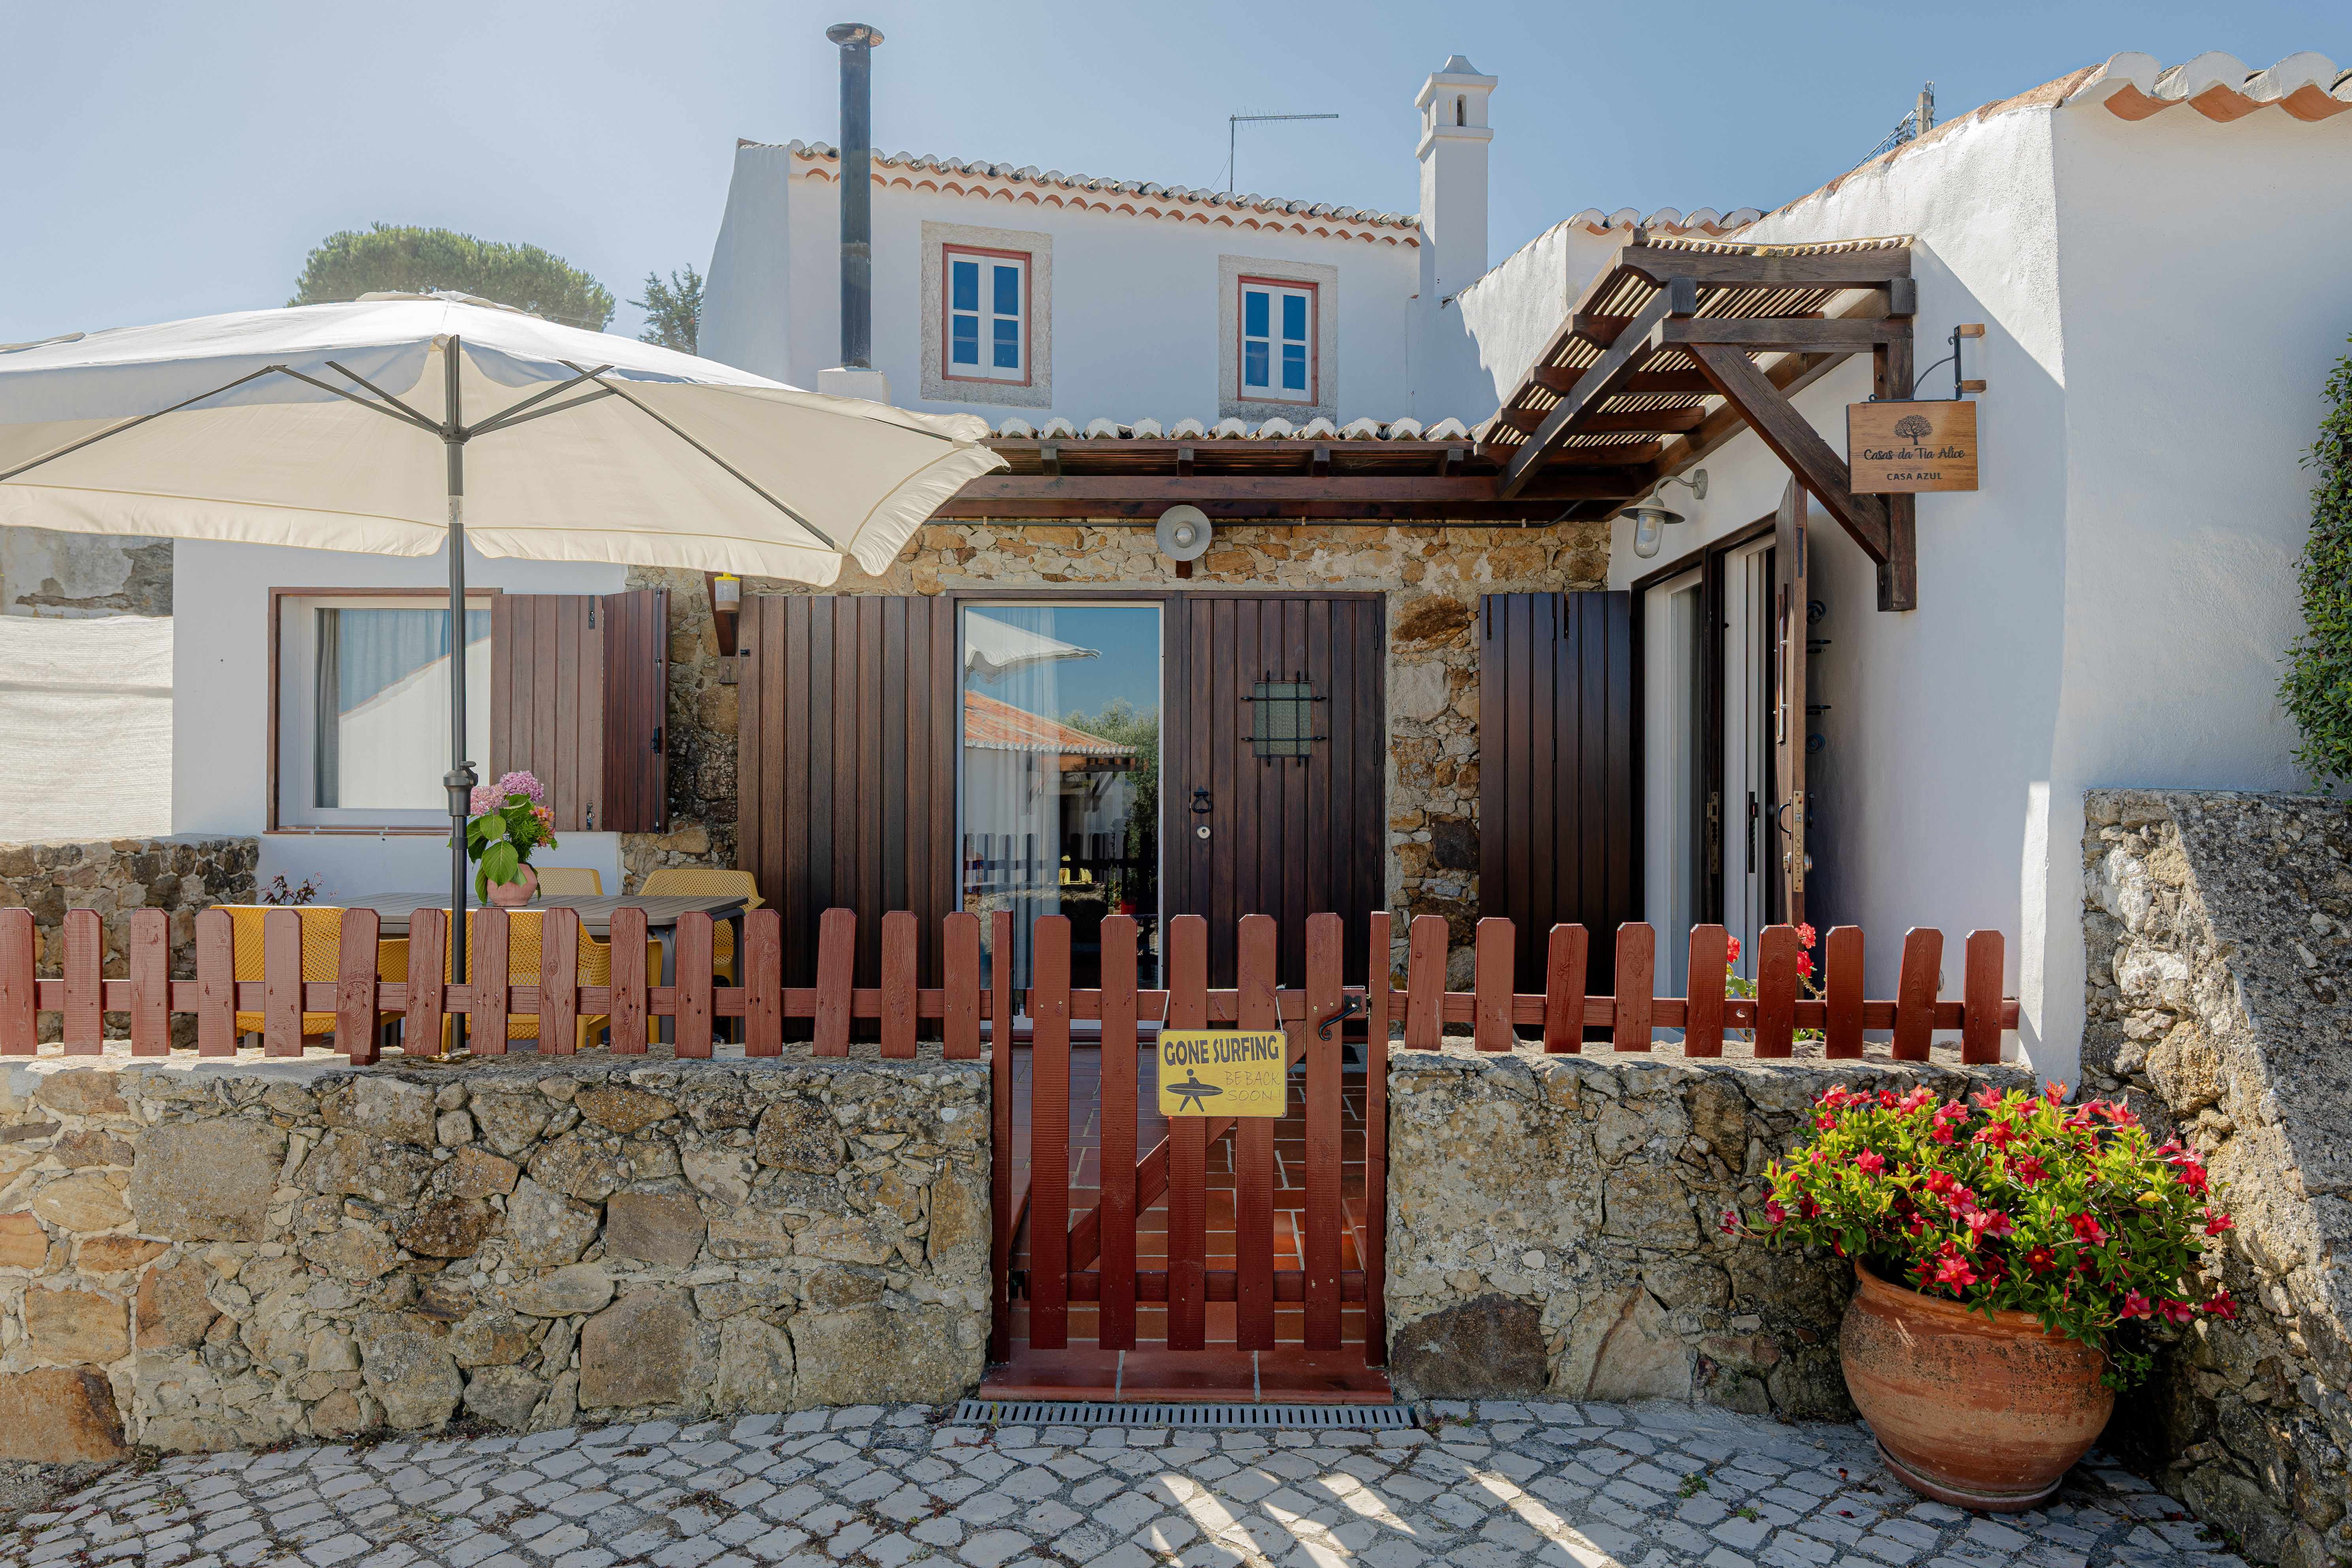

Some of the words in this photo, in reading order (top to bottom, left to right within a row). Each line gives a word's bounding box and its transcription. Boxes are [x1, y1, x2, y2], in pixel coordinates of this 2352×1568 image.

[1864, 449, 1894, 460] Casas
[1898, 448, 1913, 459] da
[1915, 448, 1935, 459] Tia
[1937, 446, 1965, 458] Alice
[1164, 1039, 1209, 1066] GONE
[1213, 1035, 1279, 1064] SURFING
[1225, 1071, 1242, 1086] BE
[1244, 1071, 1281, 1086] BACK
